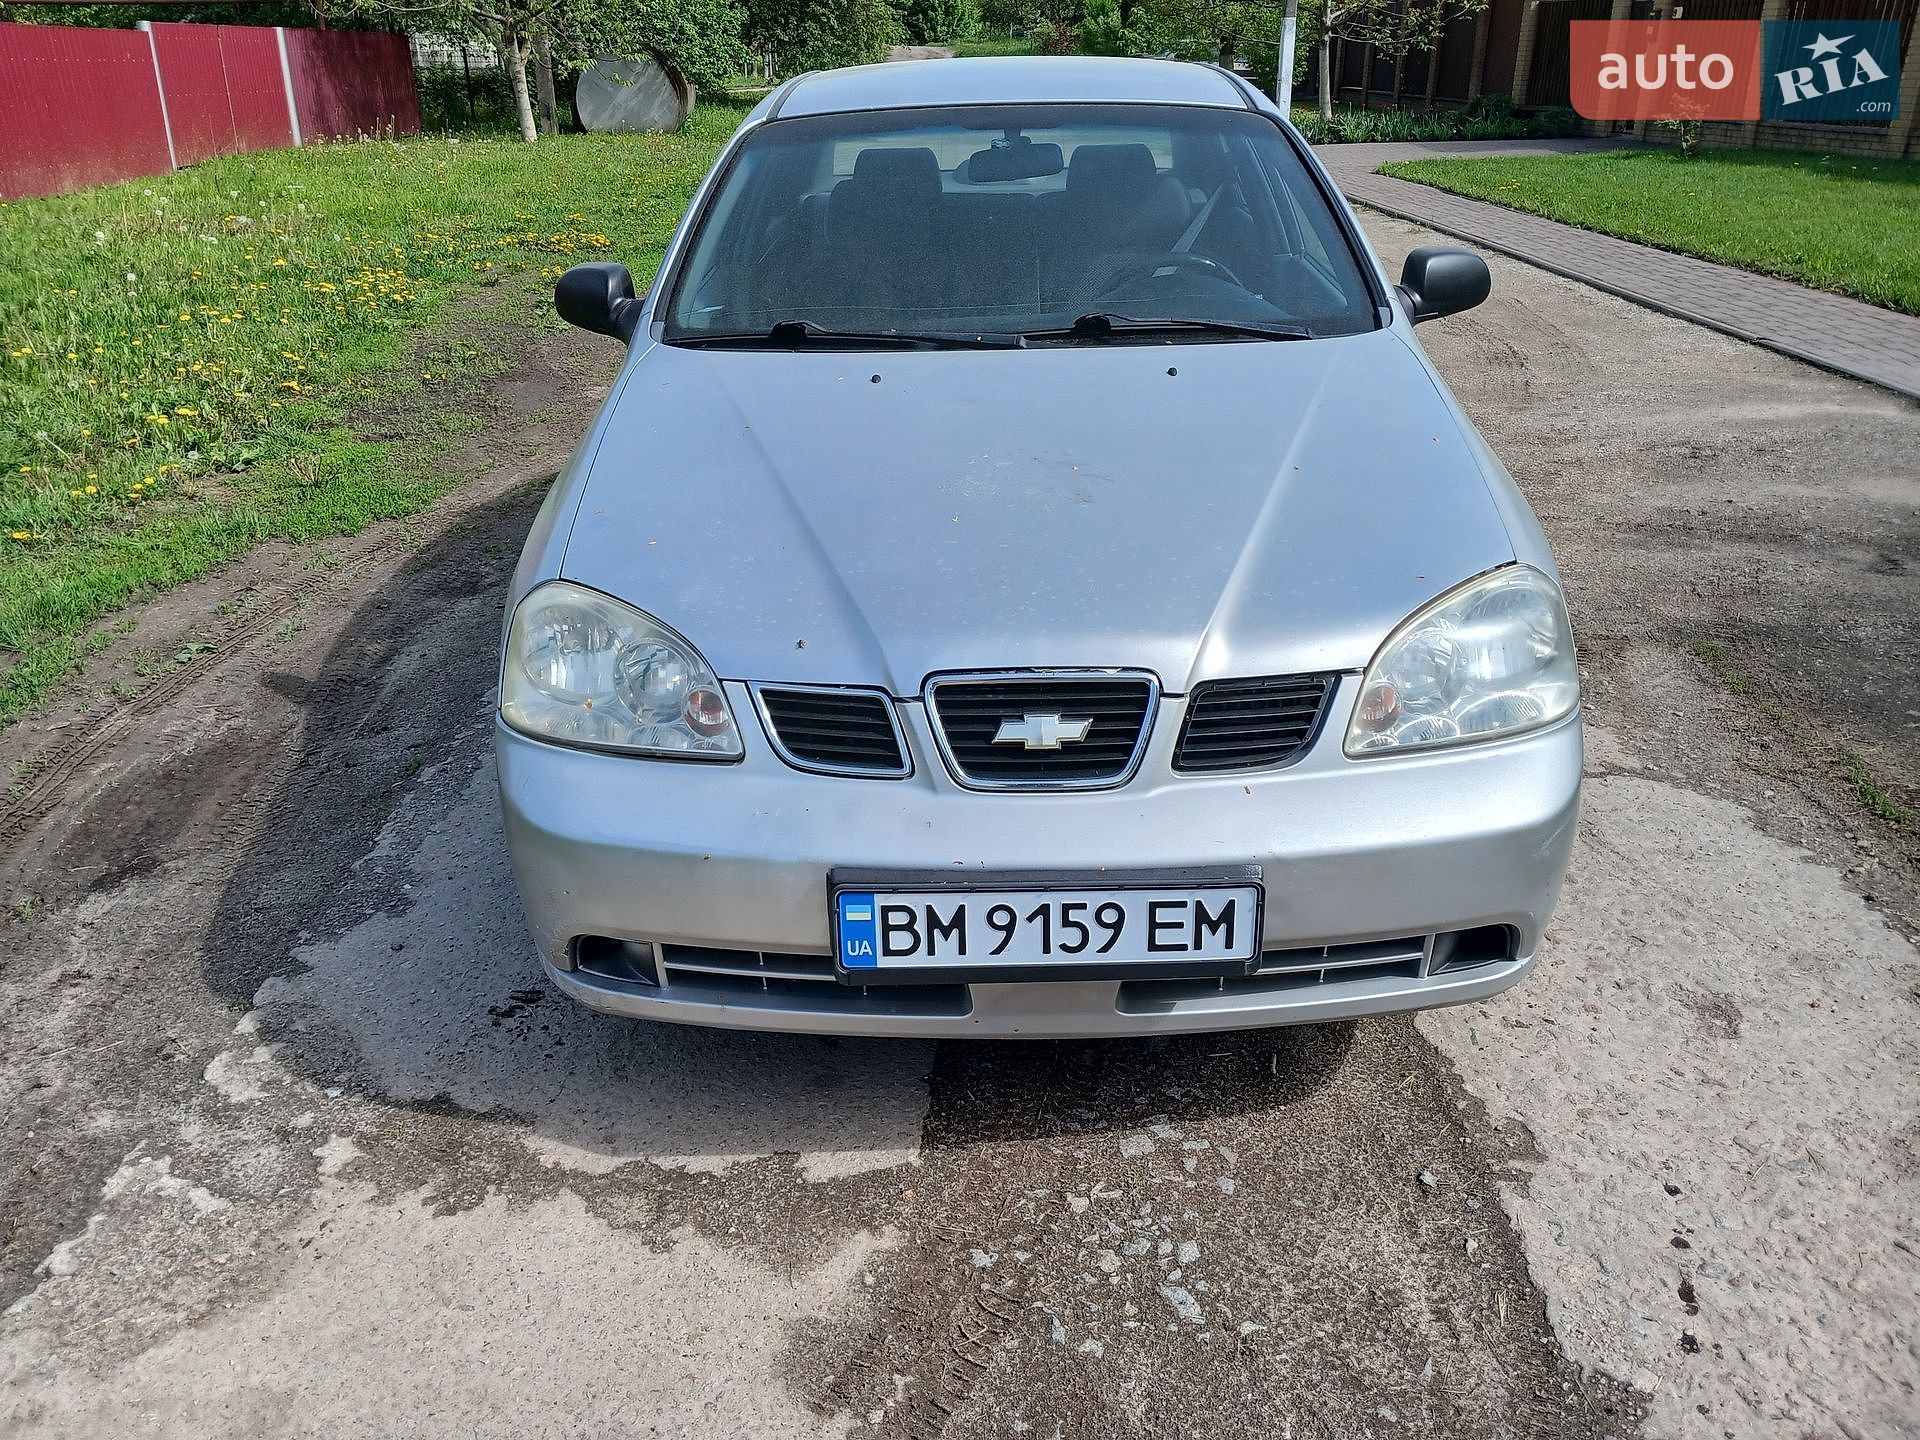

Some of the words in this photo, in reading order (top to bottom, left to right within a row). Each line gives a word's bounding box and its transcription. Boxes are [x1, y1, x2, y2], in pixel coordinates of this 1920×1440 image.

[880, 903, 968, 957] BM
[986, 901, 1126, 955] 9159
[1147, 898, 1235, 953] EM
[847, 941, 873, 956] UA
